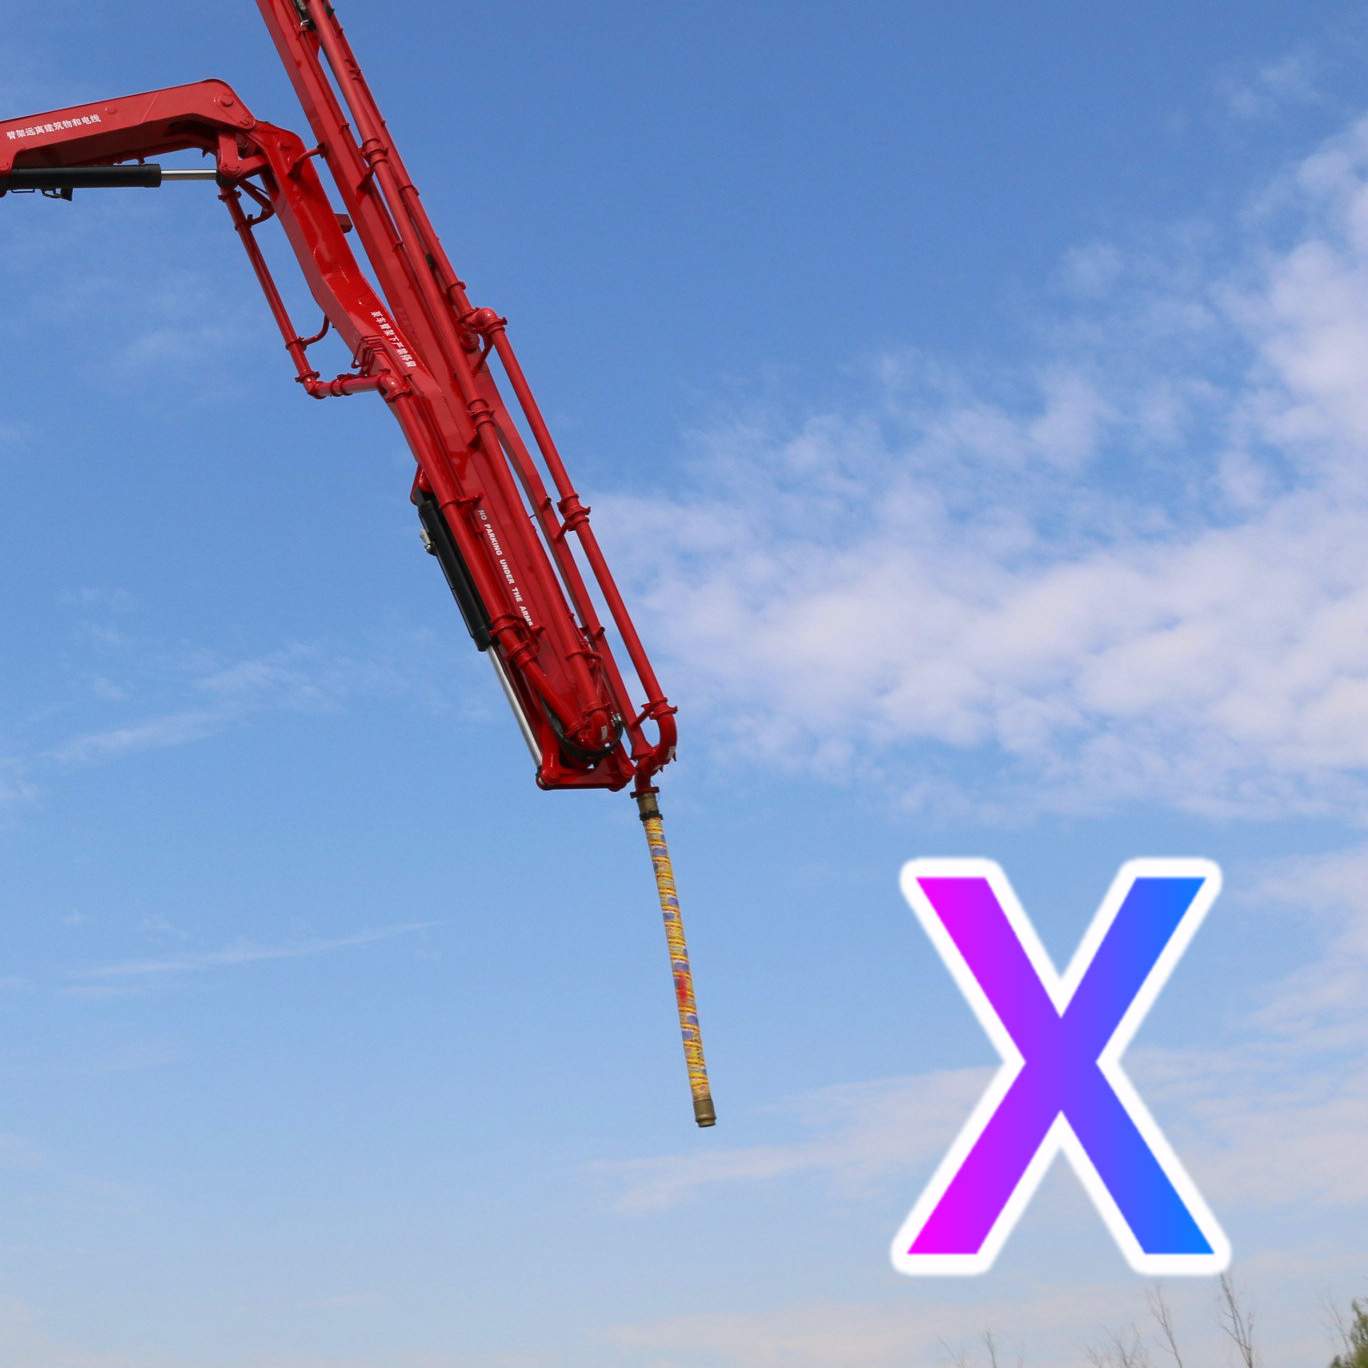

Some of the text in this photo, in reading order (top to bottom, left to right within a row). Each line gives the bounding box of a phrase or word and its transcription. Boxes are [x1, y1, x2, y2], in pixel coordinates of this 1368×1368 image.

[477, 509, 488, 521] NO
[484, 523, 503, 556] PARKING
[499, 558, 515, 585] UNDER
[511, 587, 523, 603] THE
